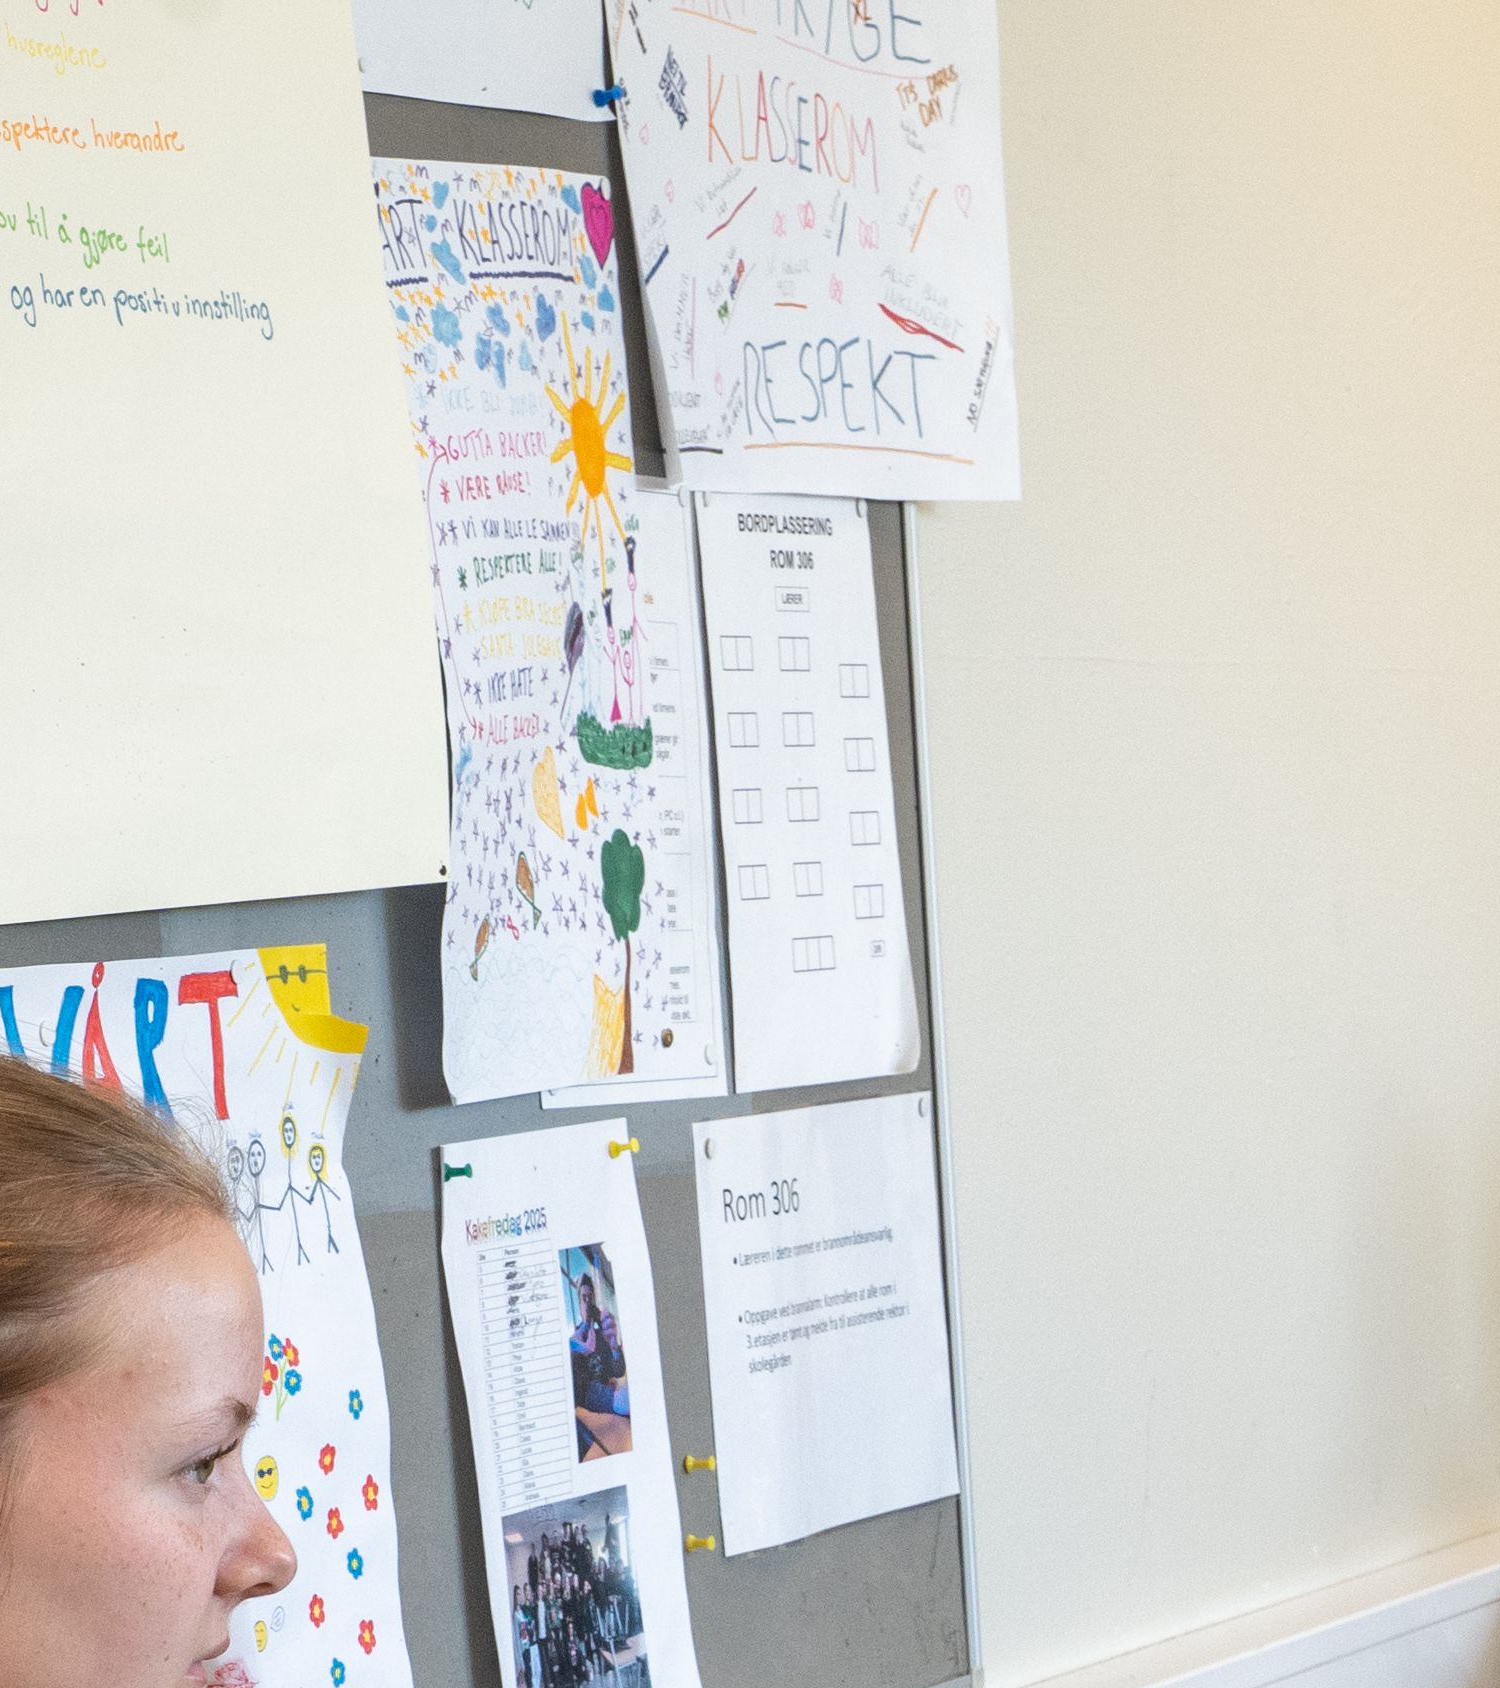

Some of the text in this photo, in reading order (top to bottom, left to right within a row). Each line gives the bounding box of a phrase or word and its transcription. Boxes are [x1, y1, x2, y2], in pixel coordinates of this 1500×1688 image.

[92, 120, 185, 152] hverandre
[706, 55, 880, 194] KLASSEROM
[26, 200, 49, 241] til
[57, 212, 72, 244] å
[79, 223, 128, 269] gjøre
[137, 231, 169, 263] feil
[453, 198, 573, 267] KLASSEROM
[10, 283, 36, 326] og
[40, 272, 75, 307] har
[80, 285, 106, 308] en
[743, 337, 937, 441] RESPEKT
[446, 429, 493, 460] GUTTA
[456, 476, 491, 501] VÆRE
[738, 513, 833, 536] BORDPLASSERING
[473, 549, 563, 586] RESPEKTERE ALLE!
[770, 550, 814, 570] ROM 306
[722, 1178, 800, 1223] Rom 306
[465, 1207, 547, 1241] Kakefredag 2025
